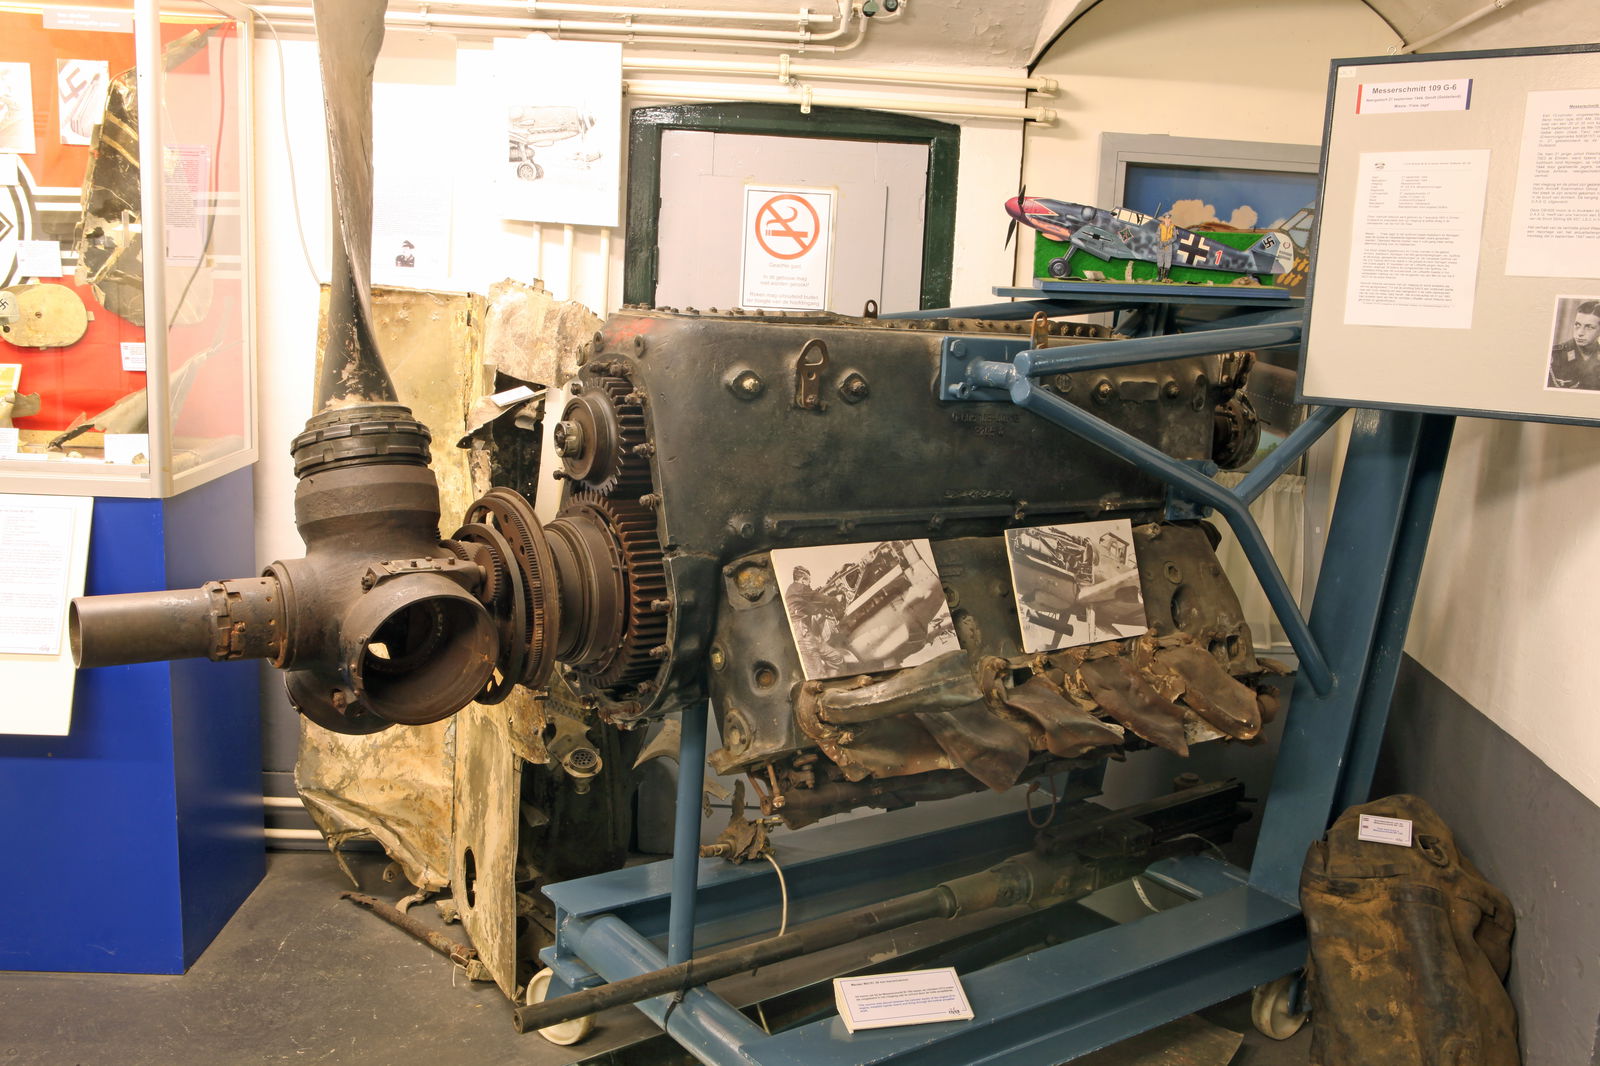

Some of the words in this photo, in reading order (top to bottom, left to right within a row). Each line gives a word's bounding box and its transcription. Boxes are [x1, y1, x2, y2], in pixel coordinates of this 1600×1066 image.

[1372, 86, 1426, 94] Messerschmitt
[1429, 84, 1442, 92] 109
[1443, 83, 1457, 91] G-6
[1214, 250, 1223, 265] 1
